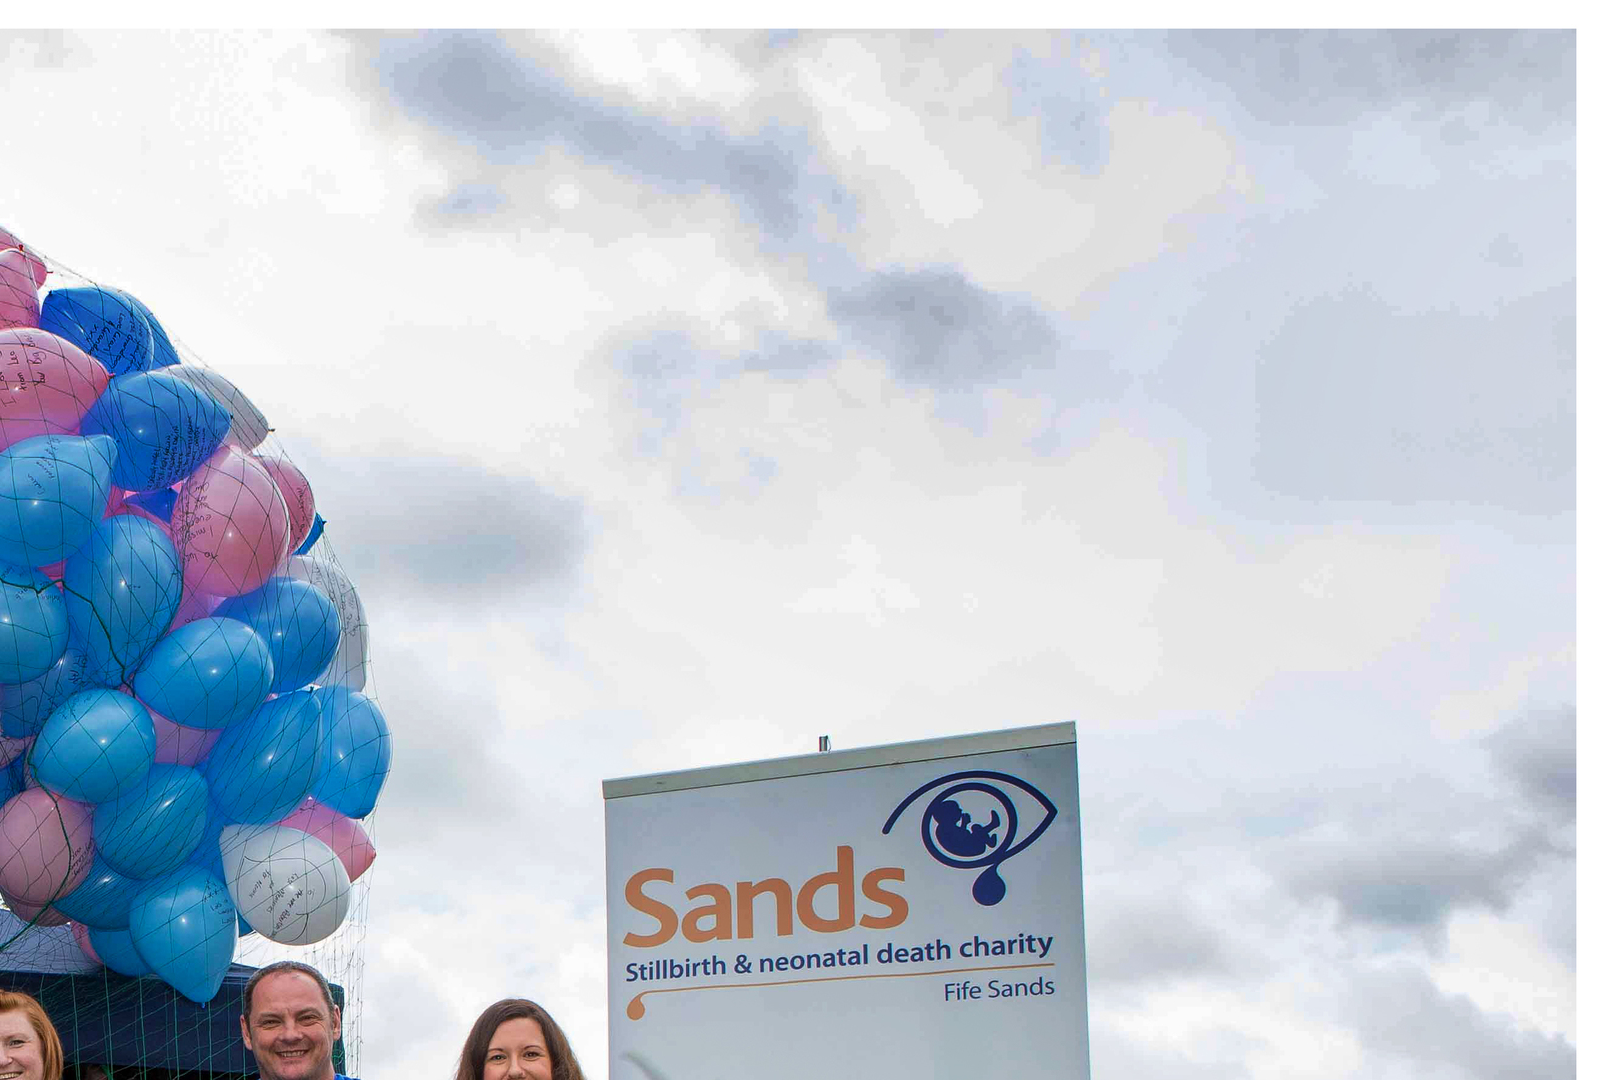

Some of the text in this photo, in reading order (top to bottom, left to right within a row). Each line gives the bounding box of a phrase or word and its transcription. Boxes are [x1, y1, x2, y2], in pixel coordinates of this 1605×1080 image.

[623, 846, 909, 948] Sands
[626, 933, 1053, 982] Stillbirth & neonatal death charity
[944, 977, 1054, 1001] Fife Sands
